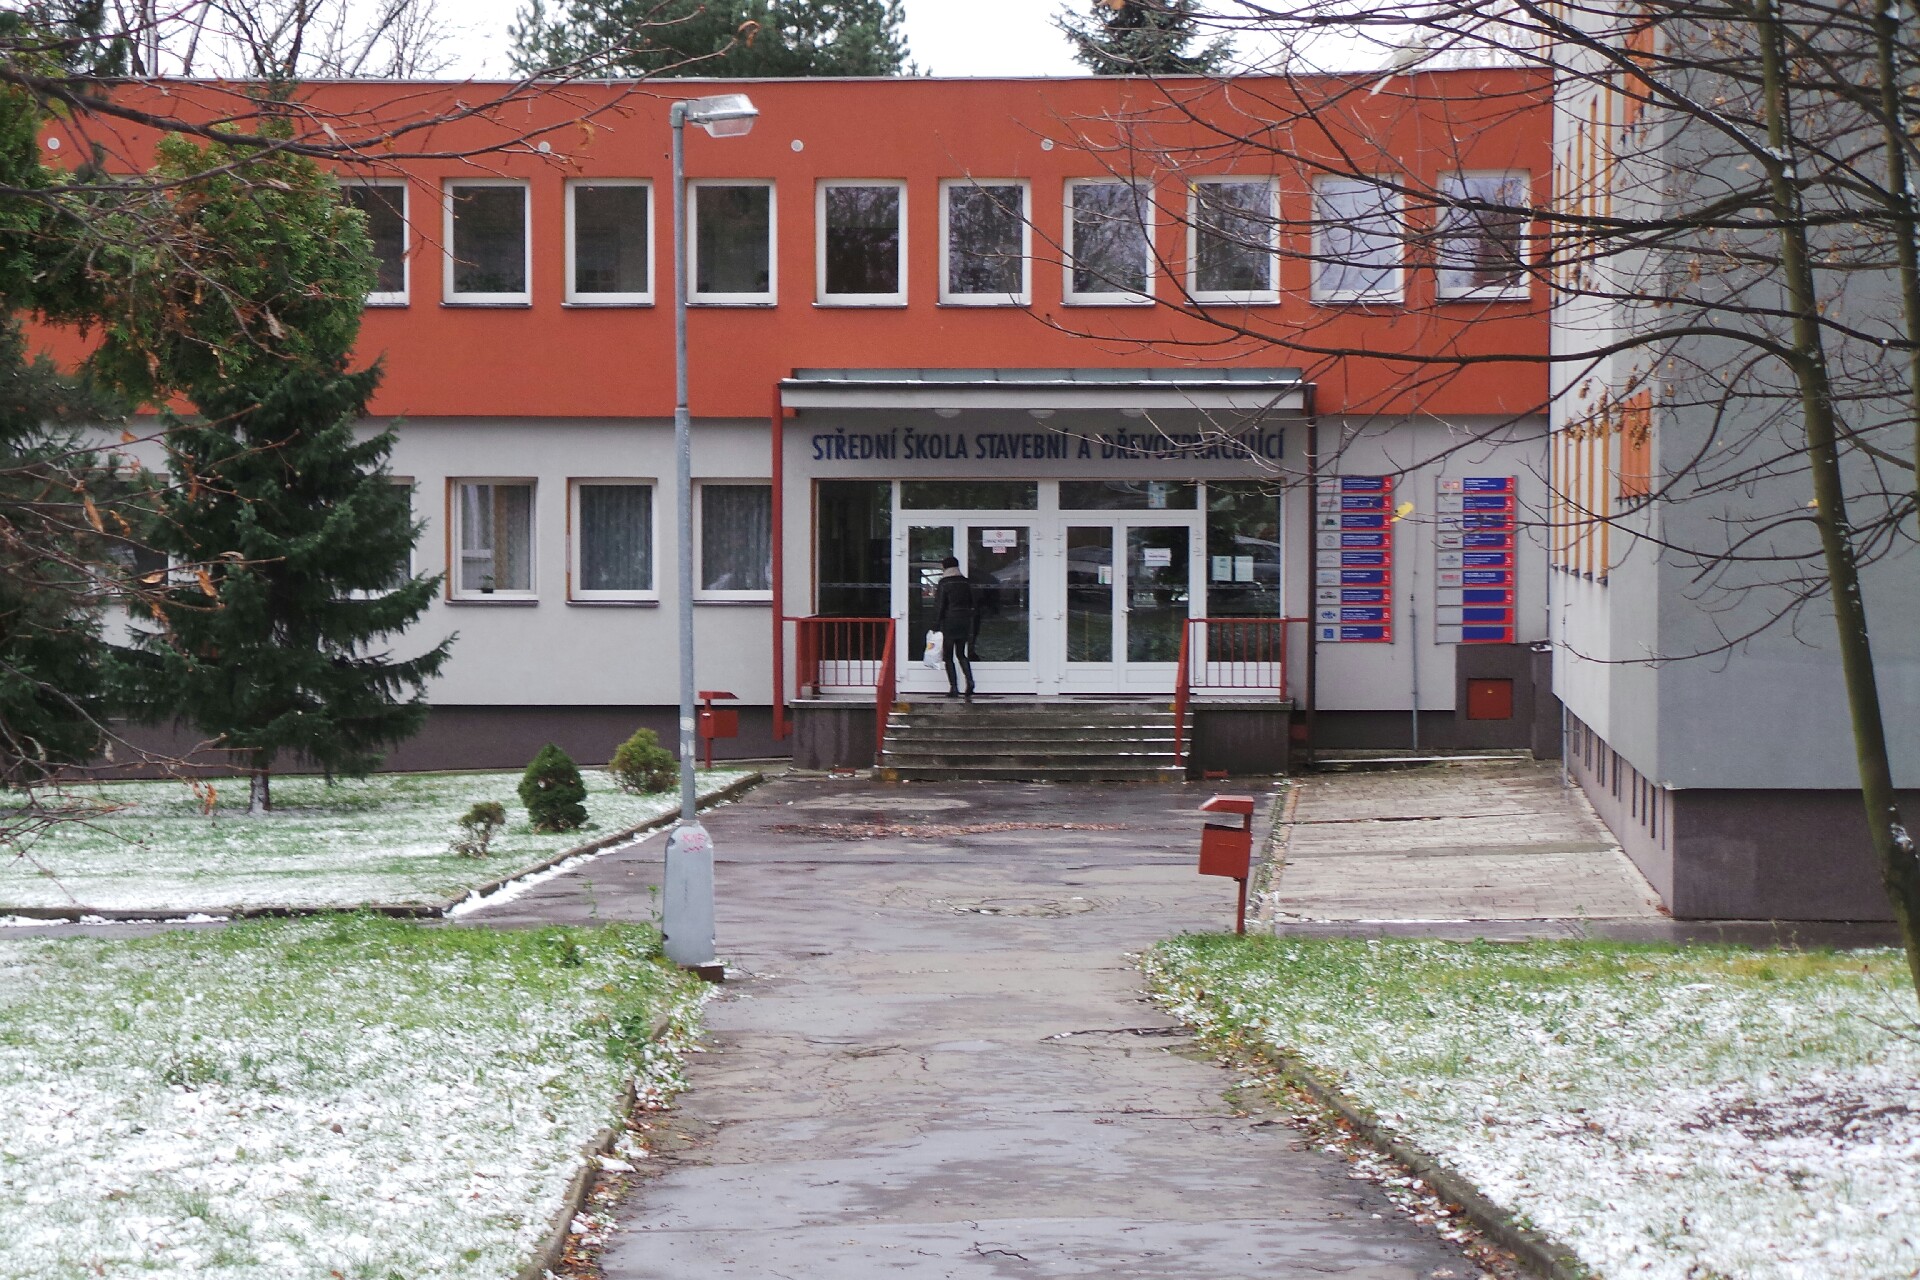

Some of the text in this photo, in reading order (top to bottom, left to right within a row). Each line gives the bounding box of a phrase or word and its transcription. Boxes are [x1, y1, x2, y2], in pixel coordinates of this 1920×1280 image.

[812, 428, 896, 460] STŘEDNÍ
[904, 428, 968, 460] ŠKOLA
[976, 428, 1068, 460] STAVEBNÍ
[1078, 434, 1091, 459] A
